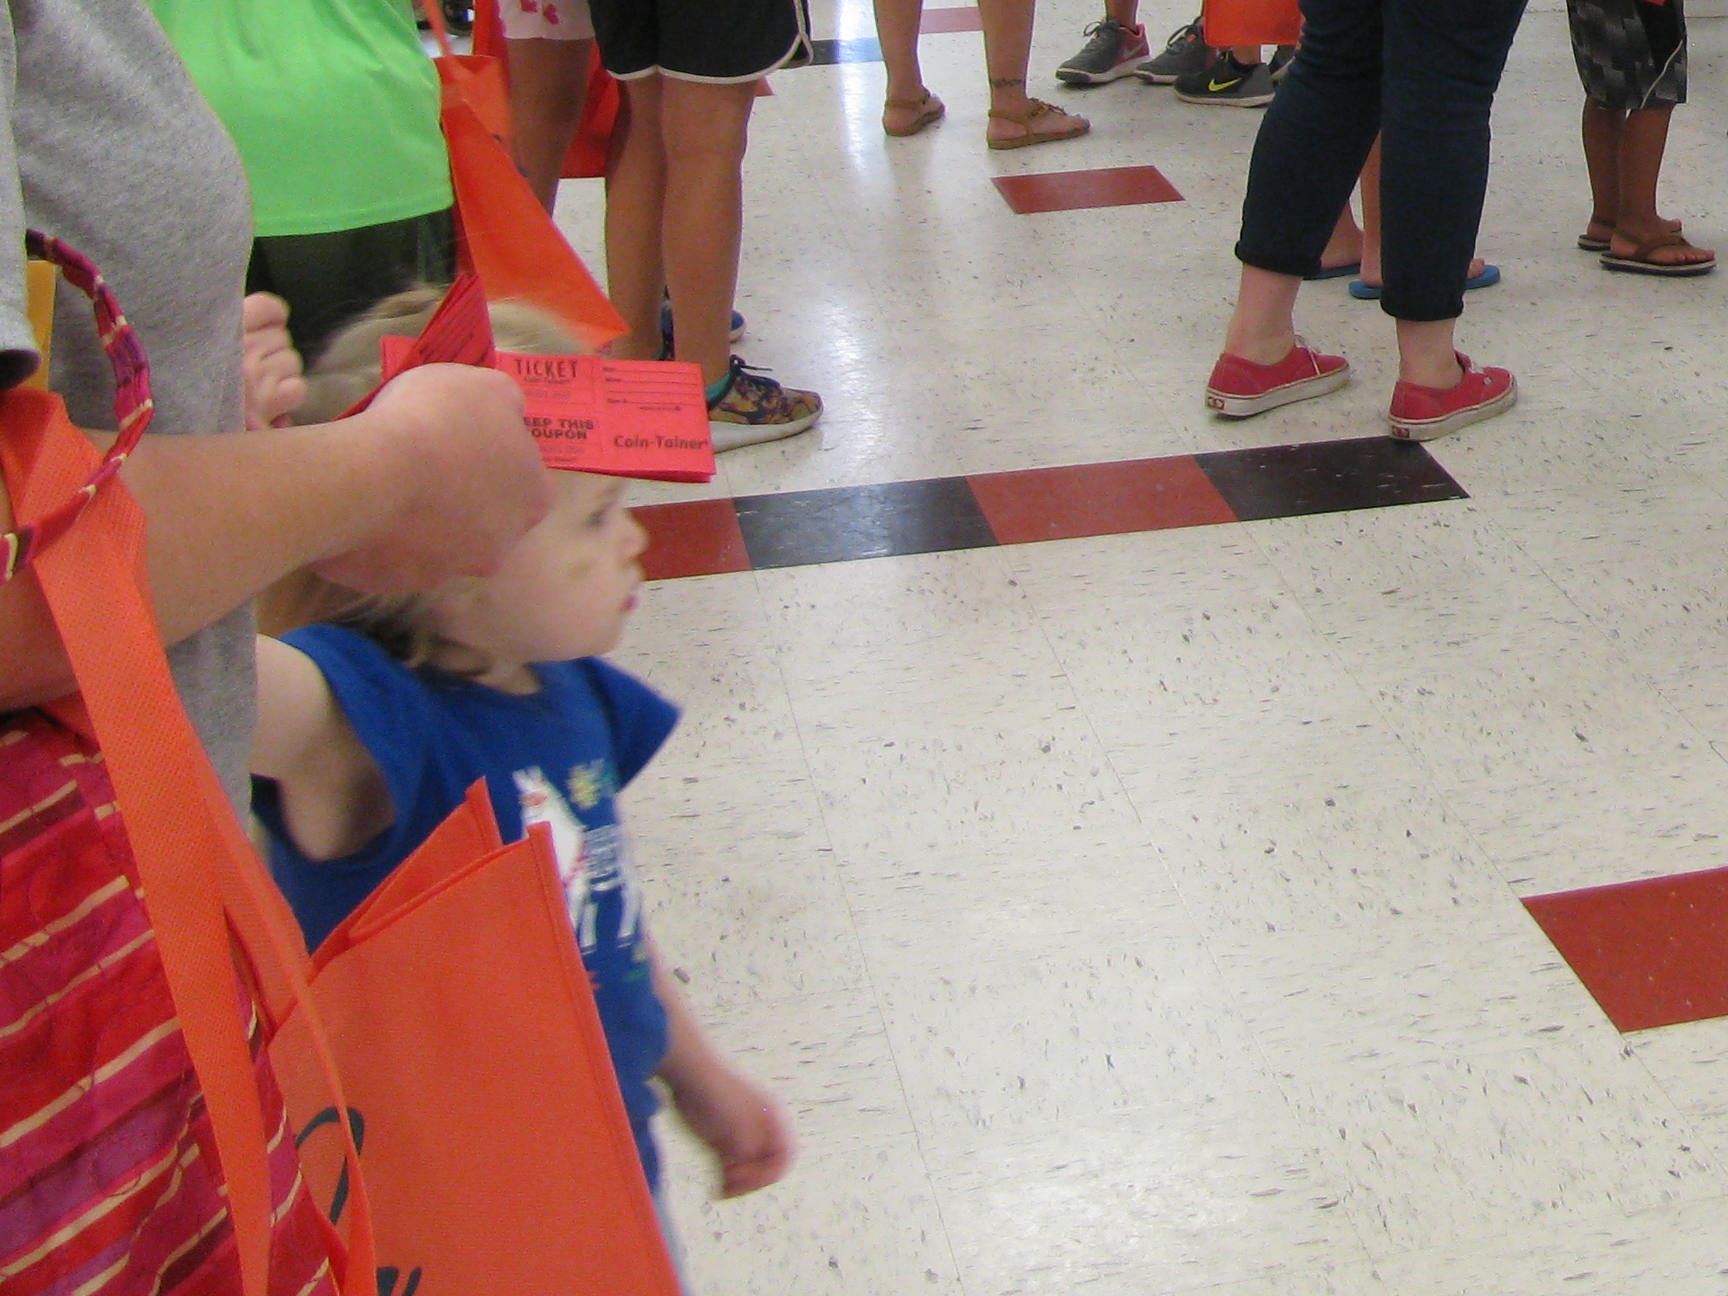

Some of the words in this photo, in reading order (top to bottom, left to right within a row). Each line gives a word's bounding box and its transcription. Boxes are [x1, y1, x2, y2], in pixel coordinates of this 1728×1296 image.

[515, 359, 578, 378] TICKET
[523, 416, 552, 427] EEP
[559, 418, 594, 430] THIS
[531, 427, 588, 440] OUPON
